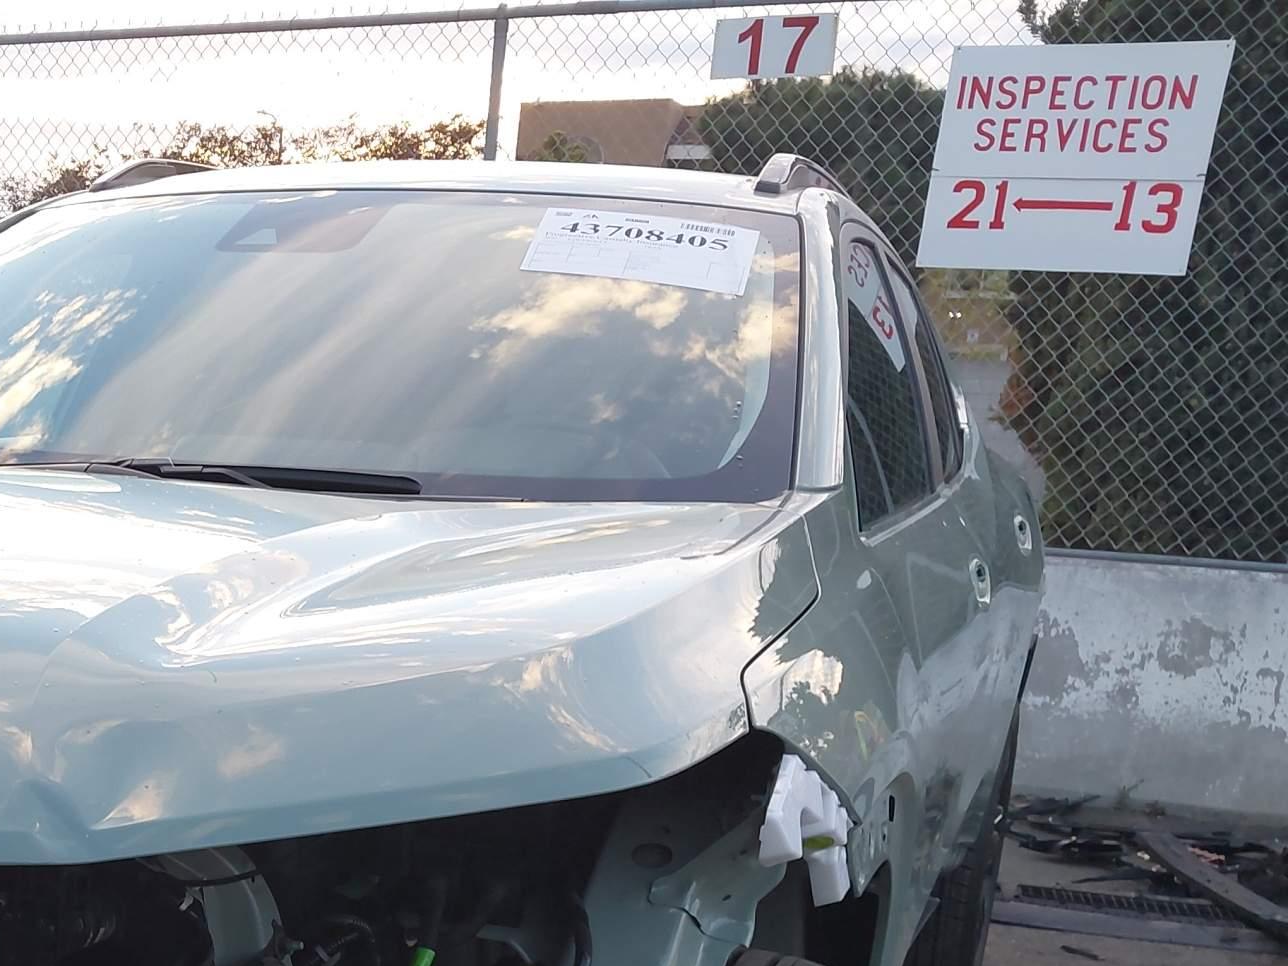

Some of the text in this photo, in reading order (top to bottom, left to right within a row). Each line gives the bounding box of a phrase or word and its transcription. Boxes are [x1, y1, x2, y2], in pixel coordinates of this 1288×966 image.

[739, 16, 819, 75] 17
[956, 74, 1198, 112] INSPECTION
[975, 118, 1169, 154] SERVICES
[947, 179, 1184, 235] 21 13
[560, 221, 730, 251] 43708405
